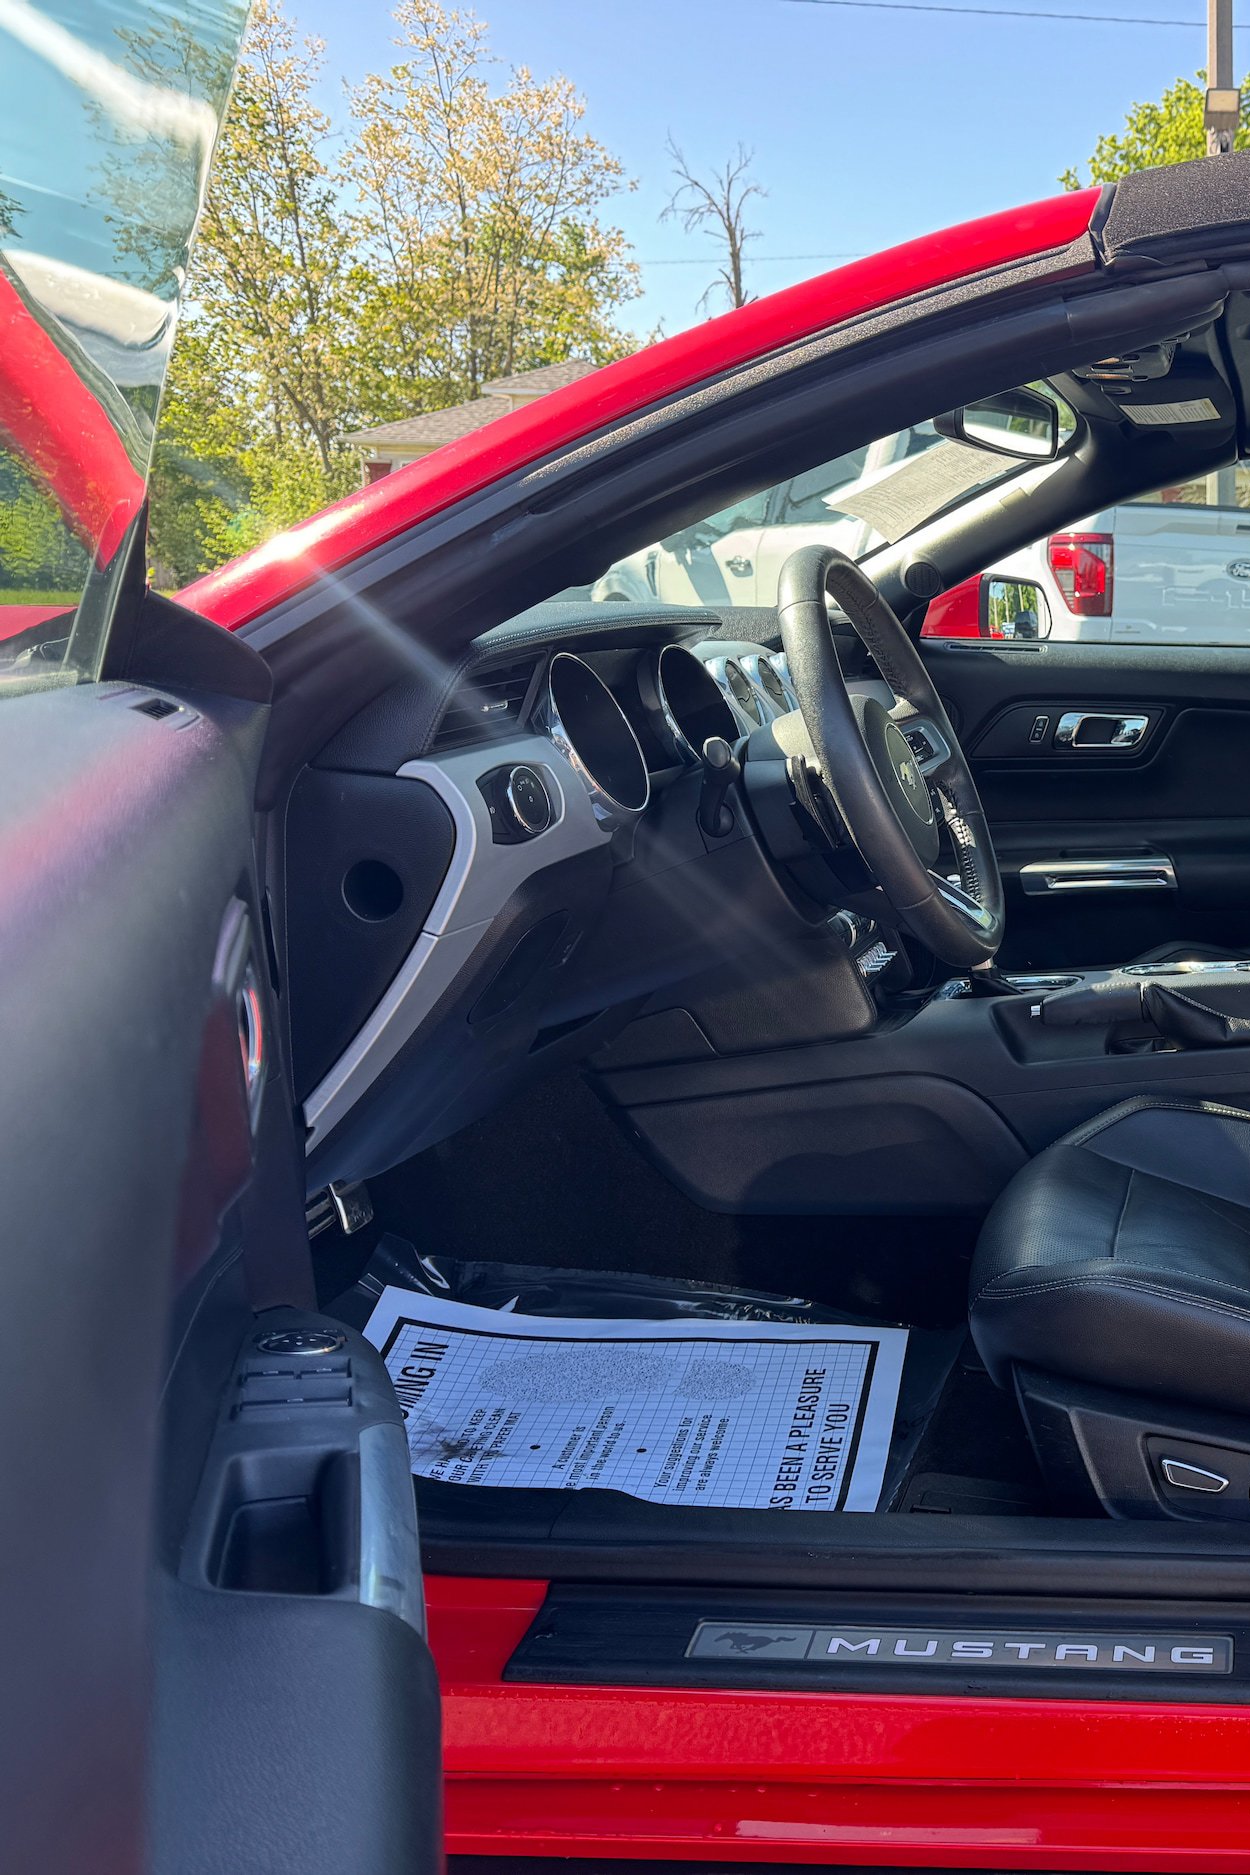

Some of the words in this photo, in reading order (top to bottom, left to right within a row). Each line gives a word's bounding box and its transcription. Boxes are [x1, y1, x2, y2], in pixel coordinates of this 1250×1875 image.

[410, 1341, 449, 1361] IN
[789, 1368, 826, 1438] PLEASURE
[468, 1408, 487, 1426] KEEP
[596, 1406, 615, 1430] person
[695, 1414, 713, 1442] service
[823, 1403, 850, 1432] YOU
[448, 1464, 469, 1482] OUR
[484, 1407, 506, 1430] CLEAN
[461, 1427, 477, 1438] TO
[558, 1433, 582, 1463] customer
[572, 1426, 586, 1435] is
[576, 1430, 605, 1460] important
[606, 1432, 621, 1440] to
[709, 1415, 731, 1451] welcome.
[466, 1463, 490, 1483] WITH
[480, 1449, 499, 1461] THS
[490, 1426, 513, 1448] PAPER
[506, 1411, 521, 1427] MAT
[600, 1440, 617, 1458] world
[654, 1471, 672, 1488] Your
[664, 1428, 689, 1470] suggestions
[679, 1417, 694, 1427] for
[690, 1442, 703, 1455] our
[785, 1442, 808, 1452] A
[811, 1437, 844, 1480] SERVE
[569, 1461, 587, 1480] most
[591, 1459, 607, 1470] the
[672, 1455, 700, 1492] improving
[699, 1452, 719, 1478] always
[773, 1456, 805, 1491] BEEN
[695, 1478, 708, 1491] are
[805, 1485, 831, 1503] TO
[826, 1636, 1215, 1665] MUSTANG
